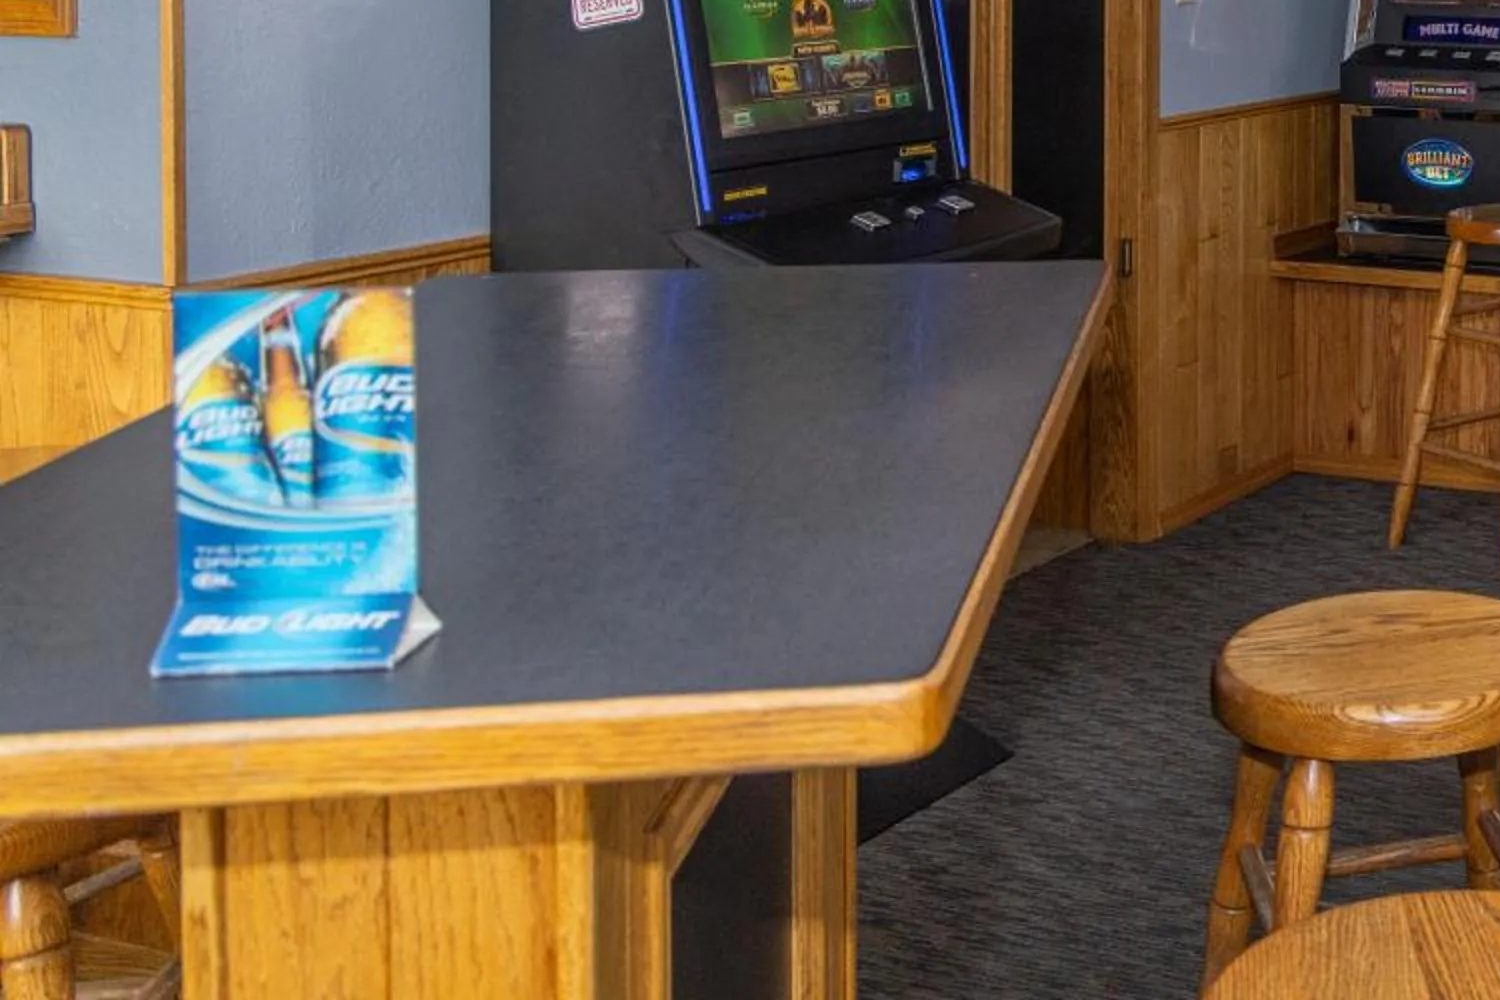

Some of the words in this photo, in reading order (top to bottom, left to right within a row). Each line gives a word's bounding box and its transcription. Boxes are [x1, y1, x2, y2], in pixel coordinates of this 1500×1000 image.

[1419, 23, 1460, 37] MULTI
[1462, 24, 1499, 39] GAME
[1407, 151, 1470, 167] BRILLIANT
[180, 614, 272, 637] BUD
[290, 610, 400, 632] LIGHT
